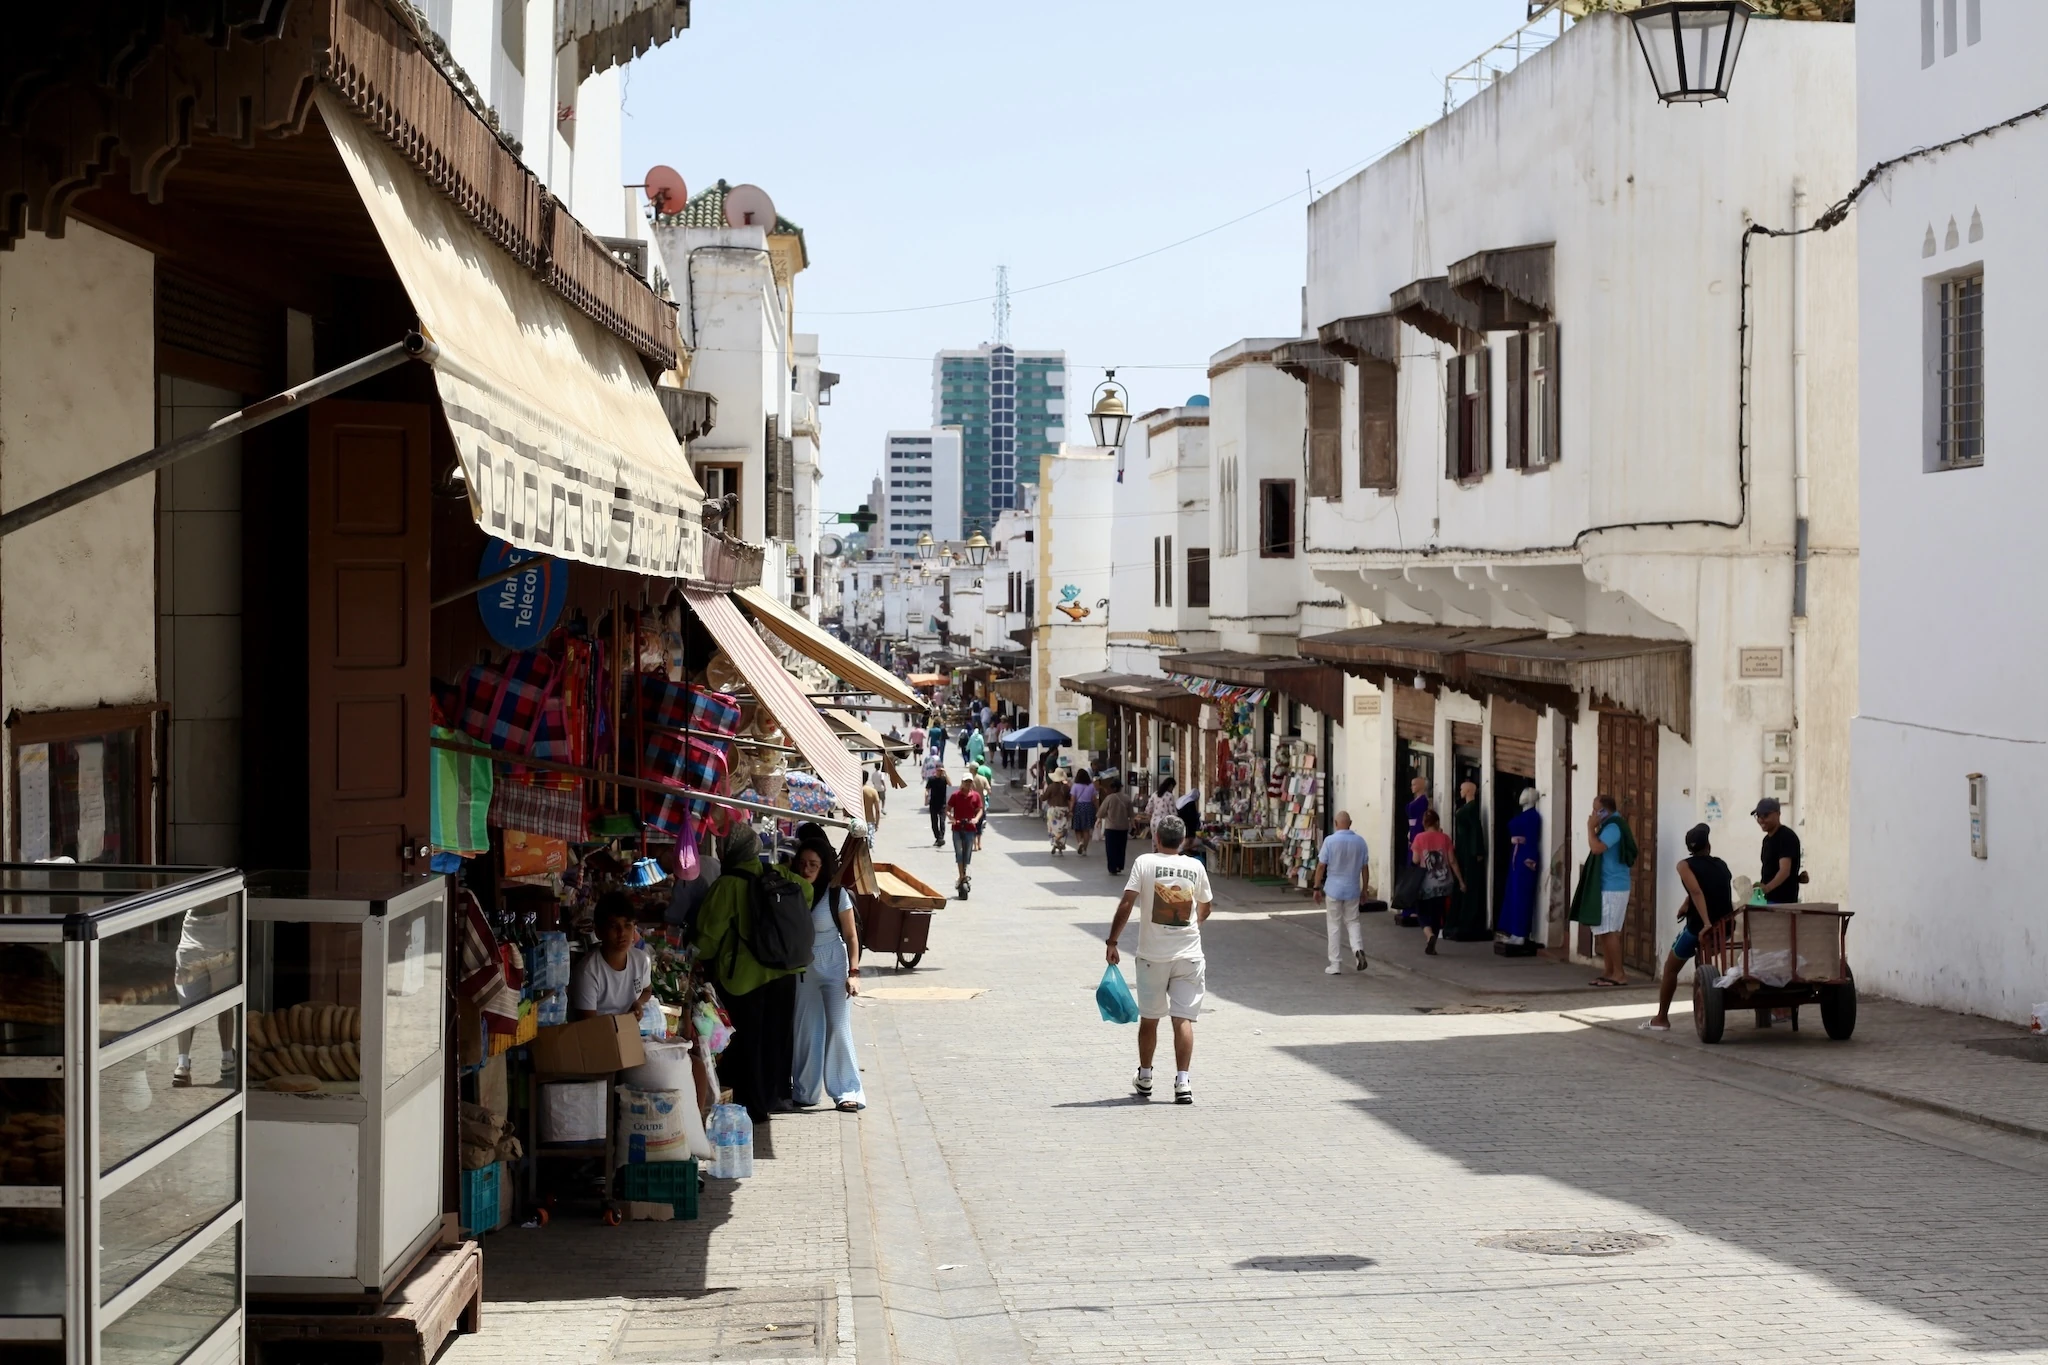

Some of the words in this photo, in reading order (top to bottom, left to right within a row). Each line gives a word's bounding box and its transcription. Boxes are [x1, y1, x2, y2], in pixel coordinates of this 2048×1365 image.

[499, 554, 521, 609] Marc
[1155, 865, 1175, 878] GET
[633, 1122, 664, 1131] COUDE
